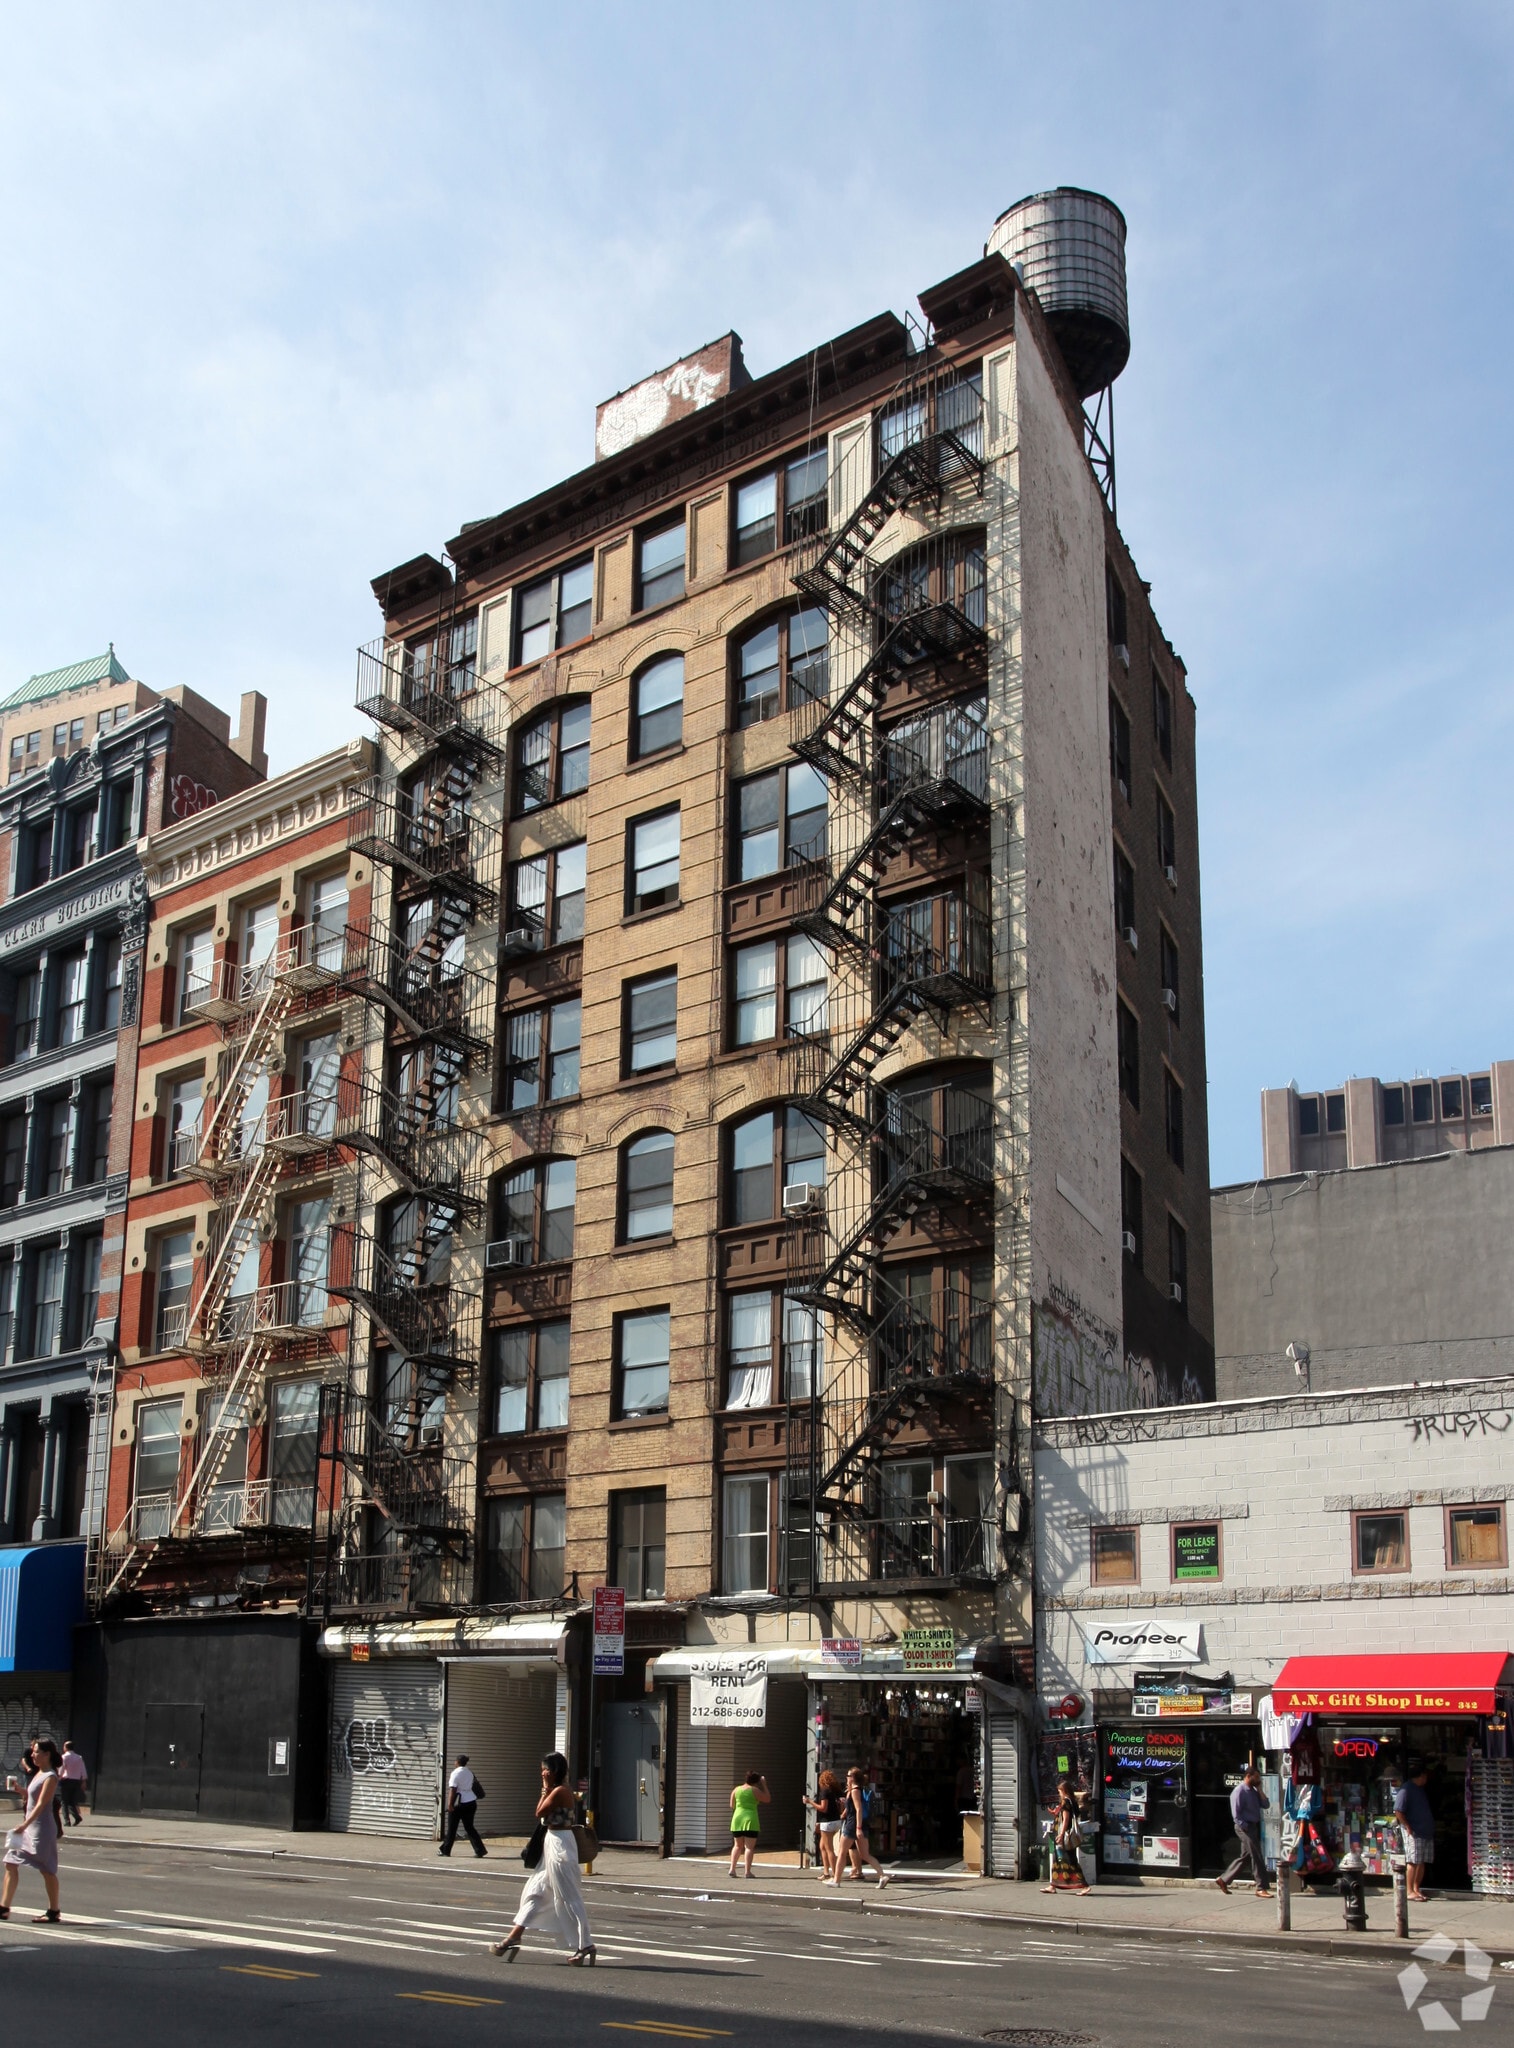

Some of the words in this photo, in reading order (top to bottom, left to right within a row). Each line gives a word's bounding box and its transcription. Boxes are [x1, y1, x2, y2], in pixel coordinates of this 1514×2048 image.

[57, 881, 122, 924] BUILDING
[1177, 1538, 1192, 1548] FOR
[1193, 1536, 1216, 1547] LEASE
[903, 1631, 922, 1640] WHITE
[1094, 1630, 1188, 1645] Pioneer
[904, 1641, 910, 1649] 7
[934, 1641, 952, 1649] $10
[903, 1650, 925, 1660] COLOR
[738, 1659, 766, 1672] FOR
[905, 1661, 911, 1669] 5
[935, 1661, 953, 1669] $10
[711, 1676, 746, 1688] RENT
[715, 1696, 740, 1705] CALL
[1289, 1695, 1324, 1706] A.N.
[1328, 1694, 1362, 1706] Gift
[1365, 1694, 1410, 1709] Shop
[1415, 1695, 1450, 1707] Inc.
[1458, 1701, 1478, 1709] 342
[692, 1707, 763, 1718] 212-686-6900
[1111, 1732, 1145, 1743] Pioneer
[1146, 1734, 1184, 1745] DENON
[1117, 1745, 1144, 1756] KICKER
[1146, 1746, 1186, 1756] BEHRINGER
[1334, 1742, 1376, 1757] OPEN
[1117, 1756, 1142, 1768] Many
[1346, 1895, 1359, 1909] 12
